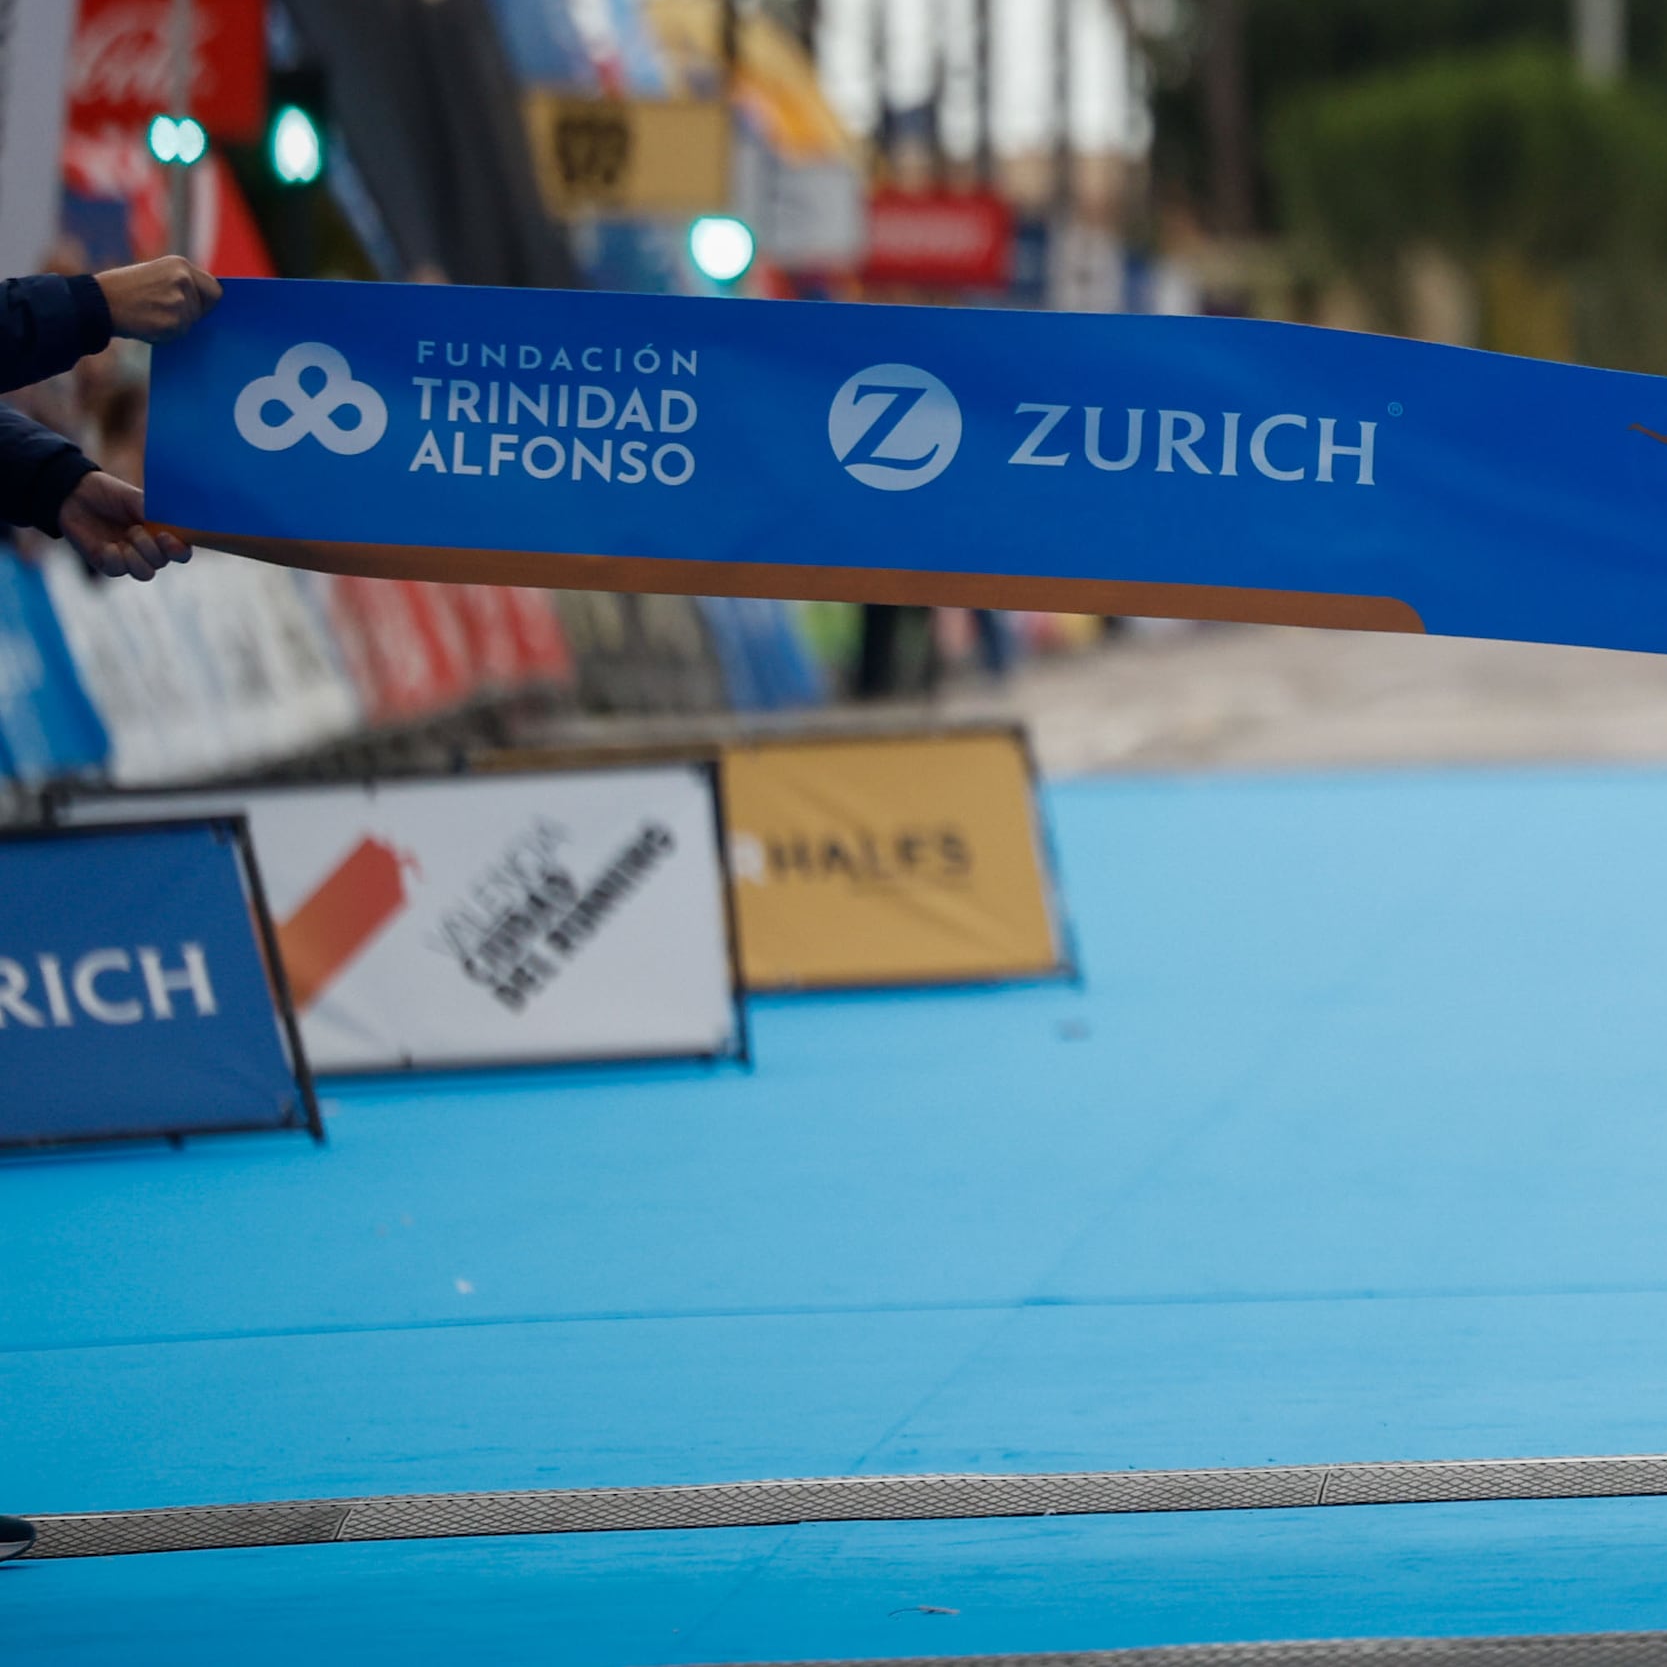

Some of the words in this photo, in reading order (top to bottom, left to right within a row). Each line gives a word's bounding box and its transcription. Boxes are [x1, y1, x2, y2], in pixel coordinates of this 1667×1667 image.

[417, 340, 700, 378] FUNDACIÓN
[412, 377, 700, 435] TRINIDAD
[409, 429, 697, 486] ALFONSO
[1008, 402, 1379, 486] ZURICH
